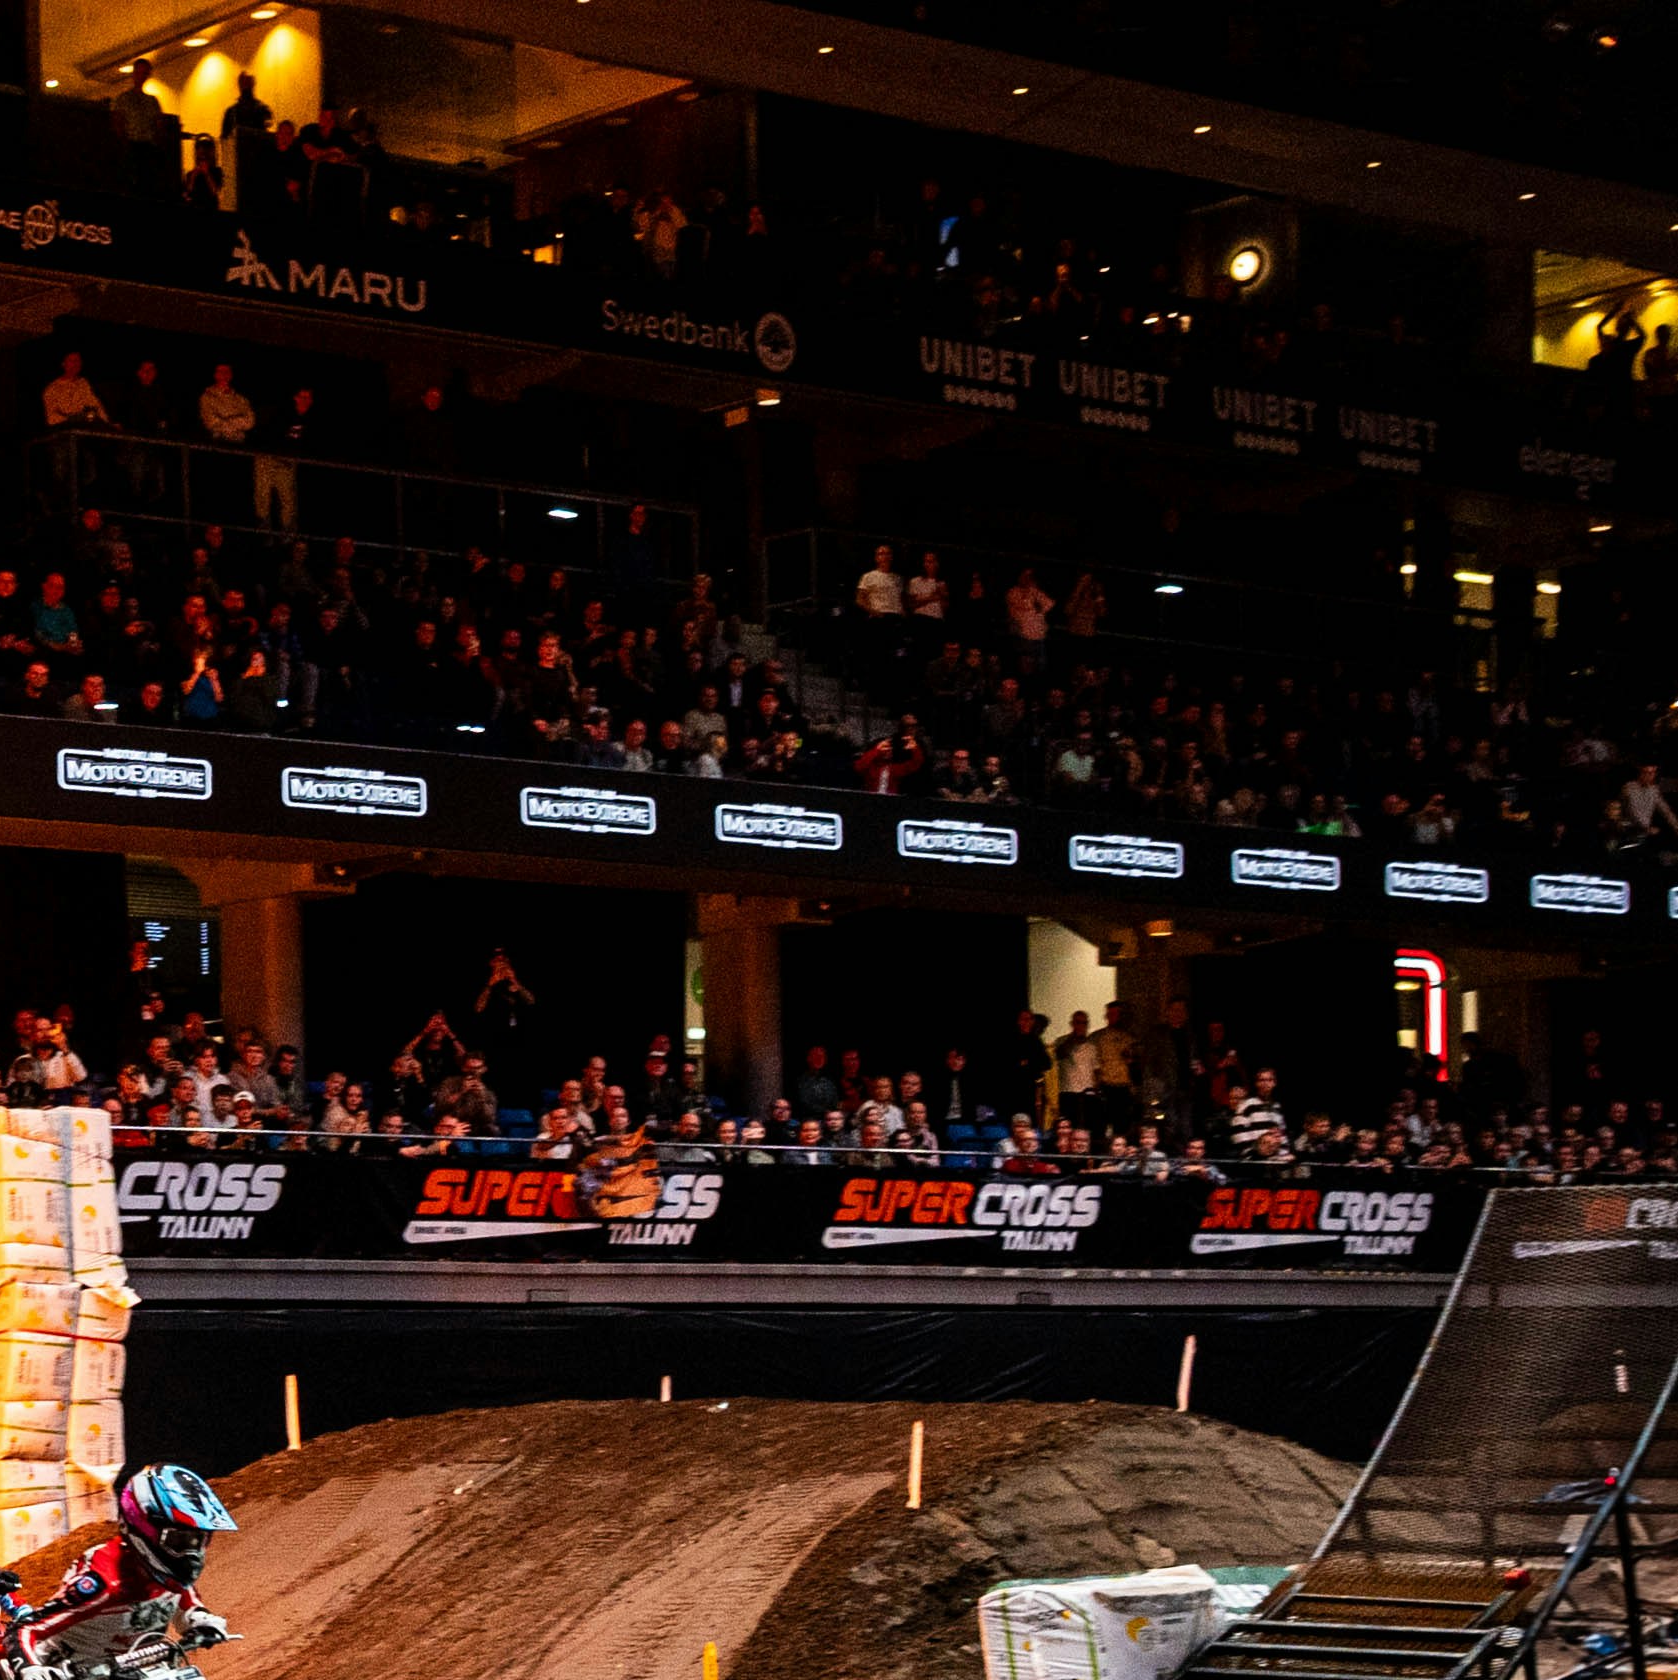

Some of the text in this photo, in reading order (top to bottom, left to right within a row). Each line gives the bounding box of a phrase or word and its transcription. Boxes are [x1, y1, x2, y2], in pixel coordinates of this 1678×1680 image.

[58, 219, 114, 247] KOSS
[287, 259, 428, 313] MARU
[601, 299, 749, 356] Swedbank
[919, 336, 1037, 389] UNIBET
[1058, 360, 1170, 409] UNIBET
[1214, 386, 1317, 436] UNIBET
[1337, 406, 1439, 454] UNIBET
[66, 759, 205, 791] MOTOEXTREME
[290, 777, 420, 808] MOTOEXTREME
[528, 797, 650, 827] MOTOEXTREME
[723, 814, 836, 842] MOTOEXTREME
[905, 829, 1013, 857] MOTOEXTREME
[1076, 844, 1179, 872] MOTOEXTREME
[117, 1161, 287, 1213] CROSS
[158, 1215, 255, 1240] TALLINN
[607, 1222, 697, 1246] TALLINN
[999, 1229, 1079, 1253] TALLINN
